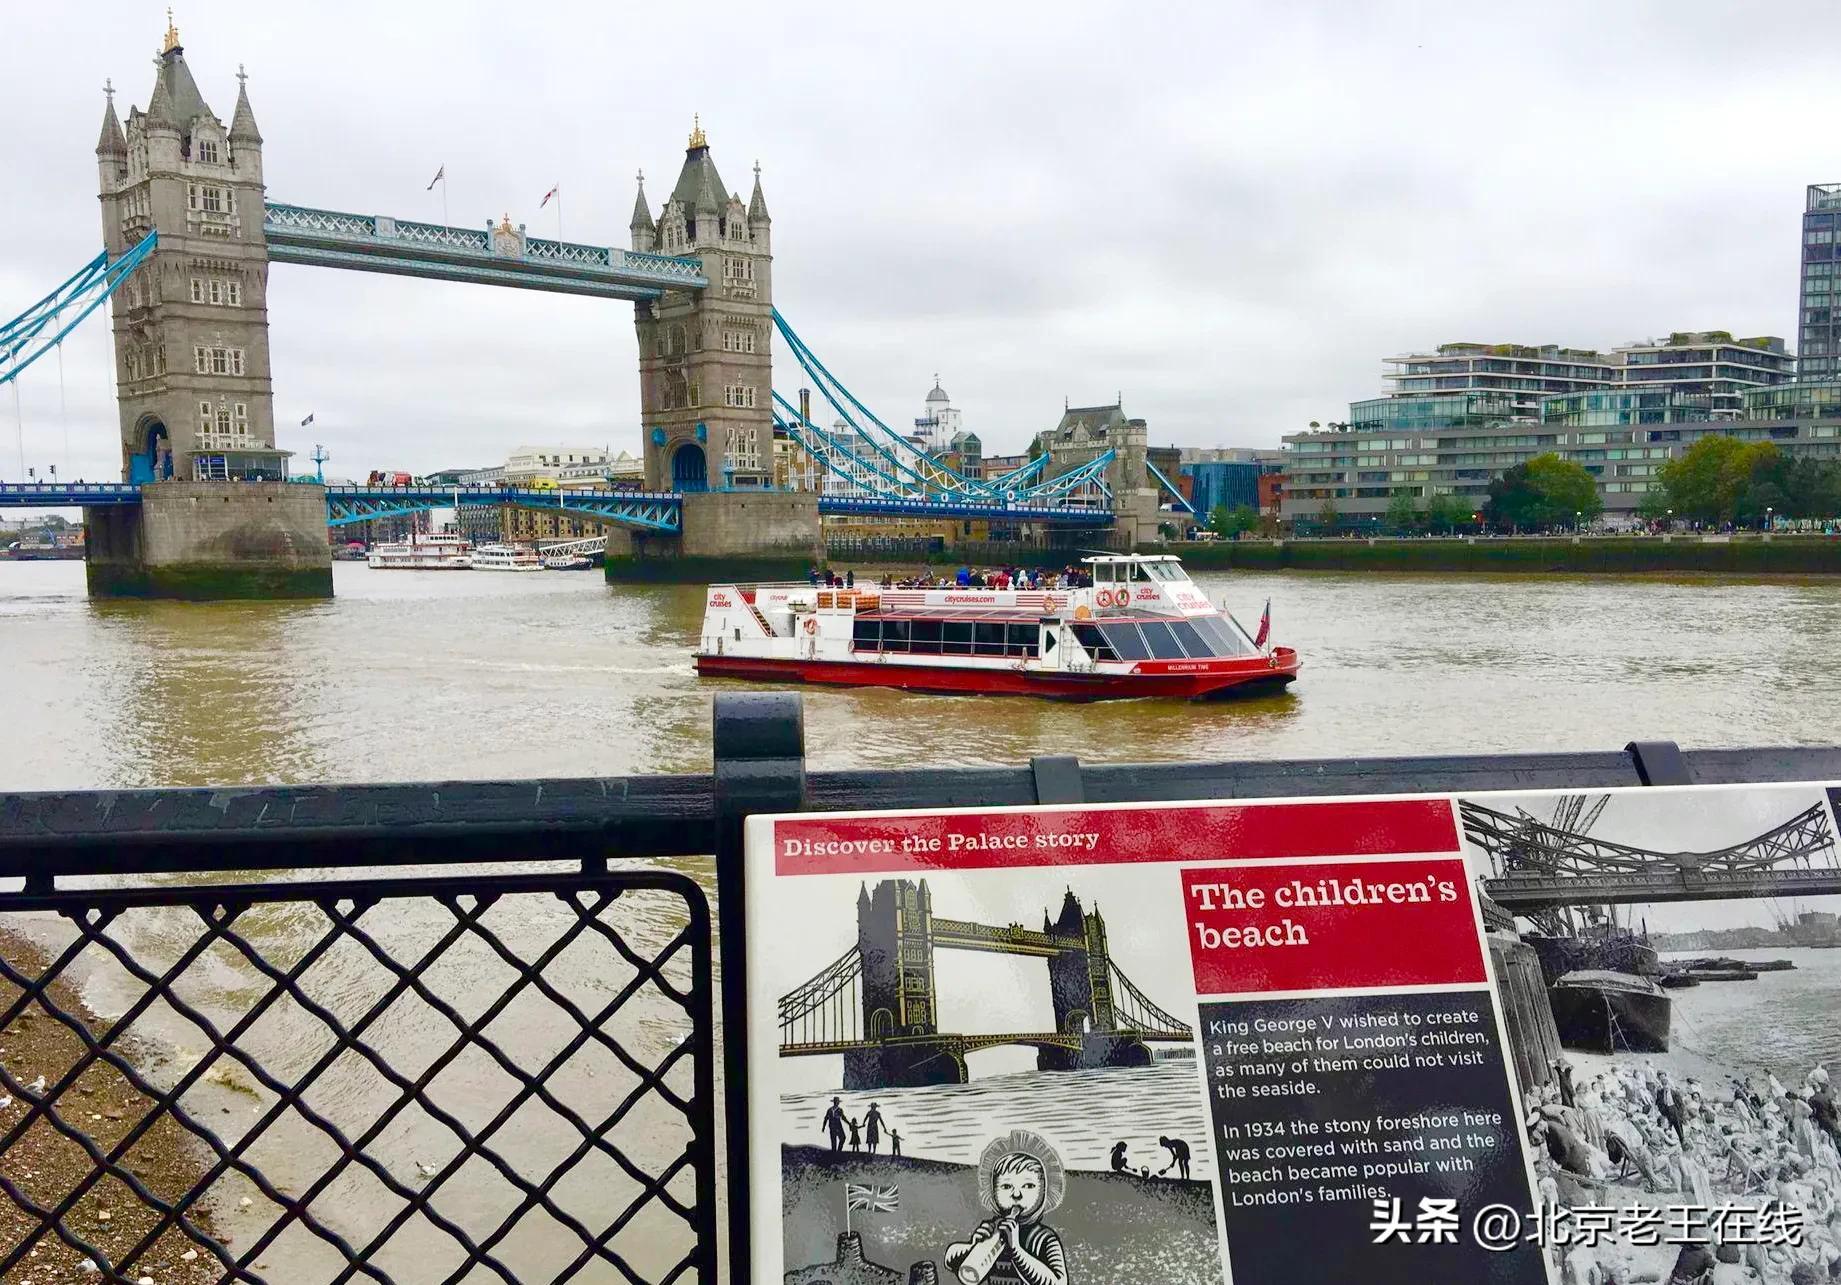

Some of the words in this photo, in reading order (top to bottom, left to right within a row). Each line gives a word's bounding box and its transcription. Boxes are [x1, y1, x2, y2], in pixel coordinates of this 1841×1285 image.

[709, 599, 732, 608] cruises
[713, 593, 726, 603] city
[944, 594, 995, 605] citycruises.com
[1140, 587, 1153, 595] city
[783, 837, 895, 857] Discover
[901, 834, 941, 852] the
[947, 833, 1029, 851] Palace
[1035, 832, 1099, 851] story
[1191, 883, 1265, 911] The
[1275, 875, 1457, 907] children's
[1195, 919, 1309, 949] beach
[1210, 1019, 1249, 1035] King
[1254, 1018, 1317, 1033] George
[1321, 1016, 1333, 1029] V
[1340, 1012, 1399, 1029] wished
[1403, 1013, 1422, 1027] to
[1426, 1010, 1479, 1025] create
[1213, 1044, 1222, 1055] a
[1226, 1041, 1259, 1055] free
[1263, 1038, 1312, 1053] beach
[1316, 1036, 1339, 1051] for
[1344, 1032, 1417, 1049] London's
[1421, 1030, 1490, 1046] children,
[1215, 1065, 1234, 1077] as
[1239, 1062, 1285, 1078] many
[1291, 1059, 1310, 1073] of
[1313, 1057, 1358, 1072] them
[1363, 1053, 1410, 1069] could
[1415, 1053, 1443, 1067] not
[1448, 1051, 1484, 1066] visit
[1217, 1084, 1246, 1099] the
[1251, 1080, 1321, 1097] seaside.
[1224, 1124, 1239, 1138] In
[1244, 1121, 1285, 1137] 1934
[1290, 1121, 1319, 1135] the
[1325, 1119, 1371, 1135] stony
[1376, 1113, 1459, 1131] foreshore
[1463, 1111, 1502, 1126] here
[1226, 1147, 1260, 1161] was
[1265, 1138, 1335, 1158] covered
[1340, 1138, 1378, 1154] with
[1383, 1136, 1425, 1153] sand
[1430, 1134, 1462, 1149] and
[1466, 1132, 1495, 1147] the
[1229, 1166, 1282, 1184] beach
[1288, 1162, 1358, 1180] became
[1364, 1159, 1431, 1178] popular
[1435, 1156, 1474, 1173] with
[1232, 1187, 1314, 1207] London's
[1318, 1183, 1391, 1201] families.
